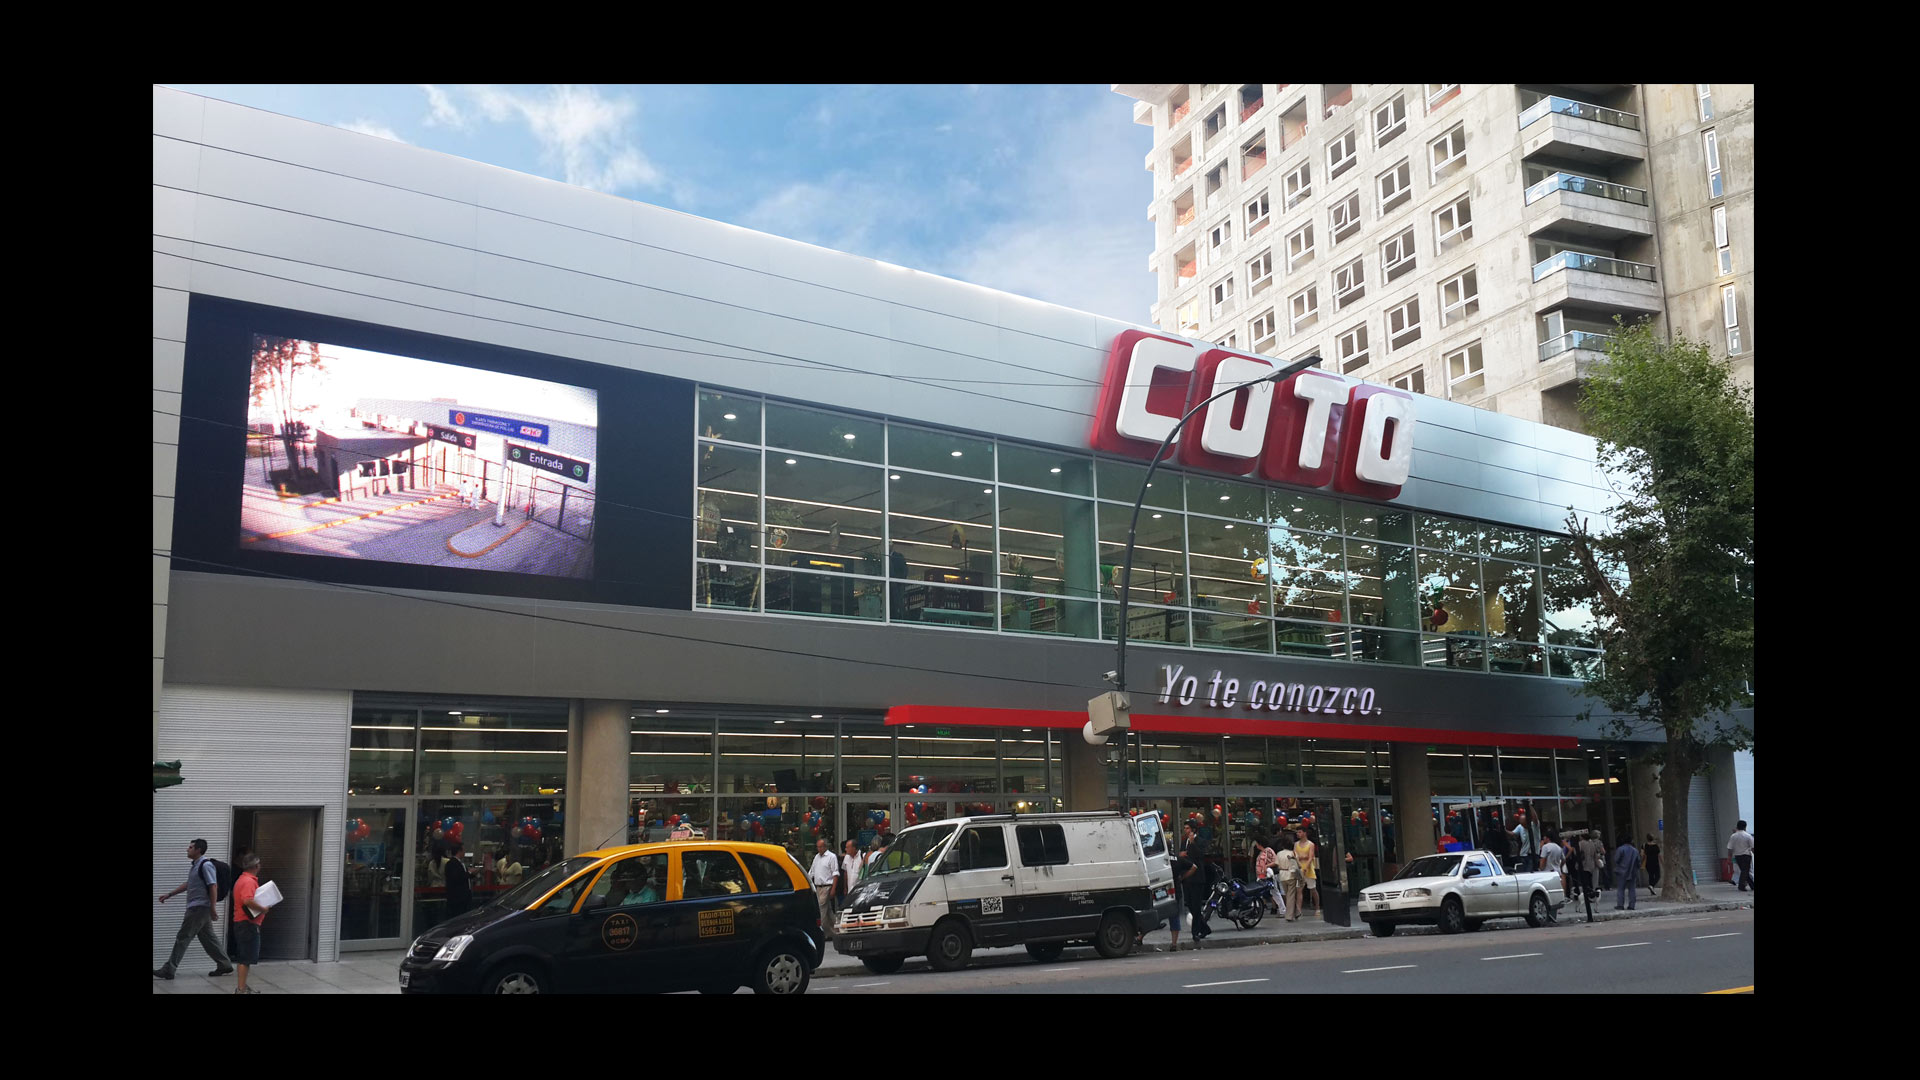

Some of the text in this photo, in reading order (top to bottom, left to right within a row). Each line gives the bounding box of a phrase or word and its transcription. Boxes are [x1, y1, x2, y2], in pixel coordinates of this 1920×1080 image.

[1115, 336, 1417, 487] COTO
[529, 453, 564, 470] Entrada
[1160, 664, 1382, 716] Yo te conozco.
